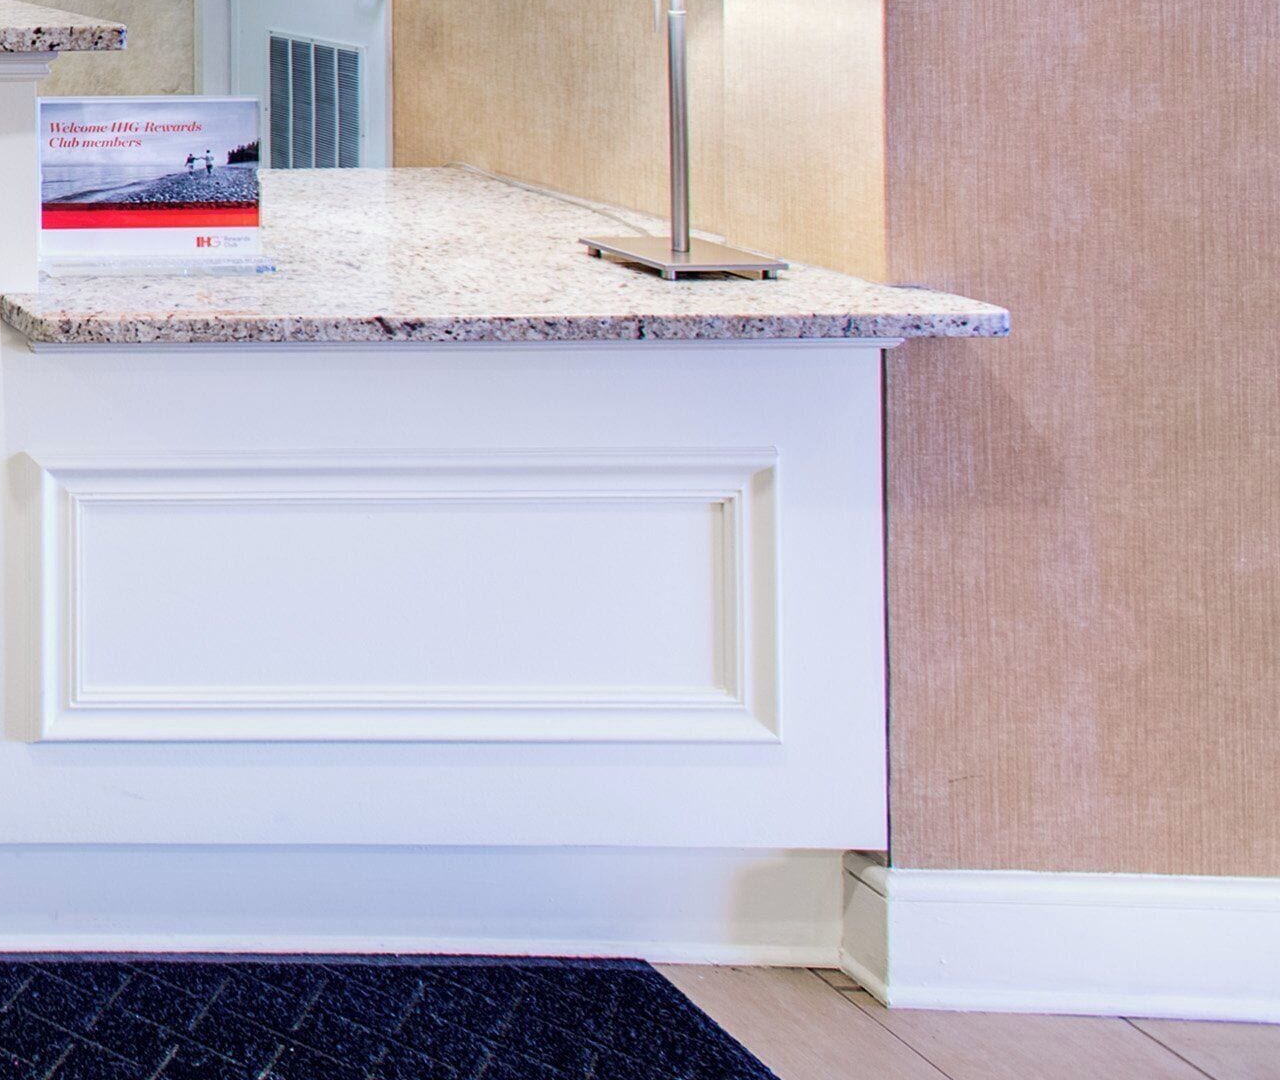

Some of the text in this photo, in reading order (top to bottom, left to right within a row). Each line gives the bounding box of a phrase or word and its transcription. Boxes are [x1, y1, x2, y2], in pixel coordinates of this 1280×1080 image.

[49, 121, 202, 133] Welcome IHG Rewards
[49, 137, 142, 148] Club members
[196, 236, 221, 248] IHG
